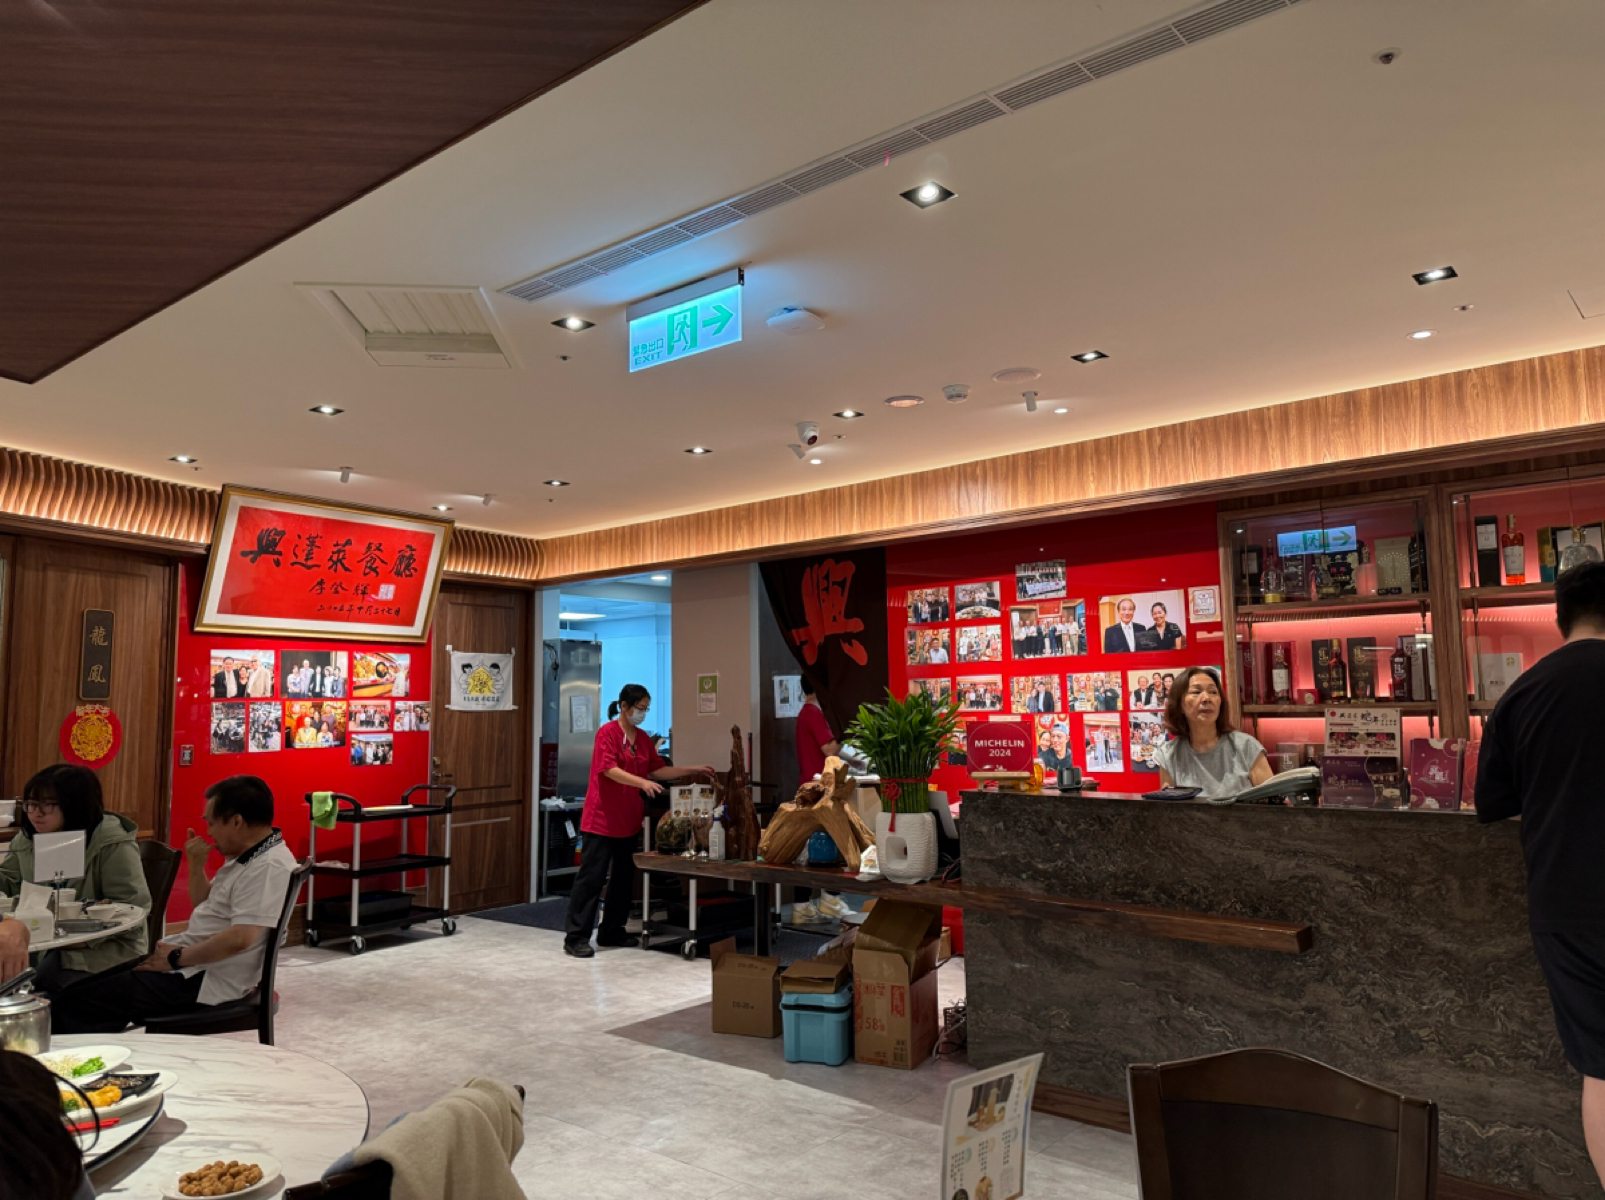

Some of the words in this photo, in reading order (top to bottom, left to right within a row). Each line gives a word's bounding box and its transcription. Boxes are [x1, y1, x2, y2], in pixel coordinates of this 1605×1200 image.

[633, 338, 664, 357] 緊急出口
[634, 351, 662, 366] EXIT
[974, 739, 1025, 748] MICHELIN
[988, 748, 1012, 757] 2024
